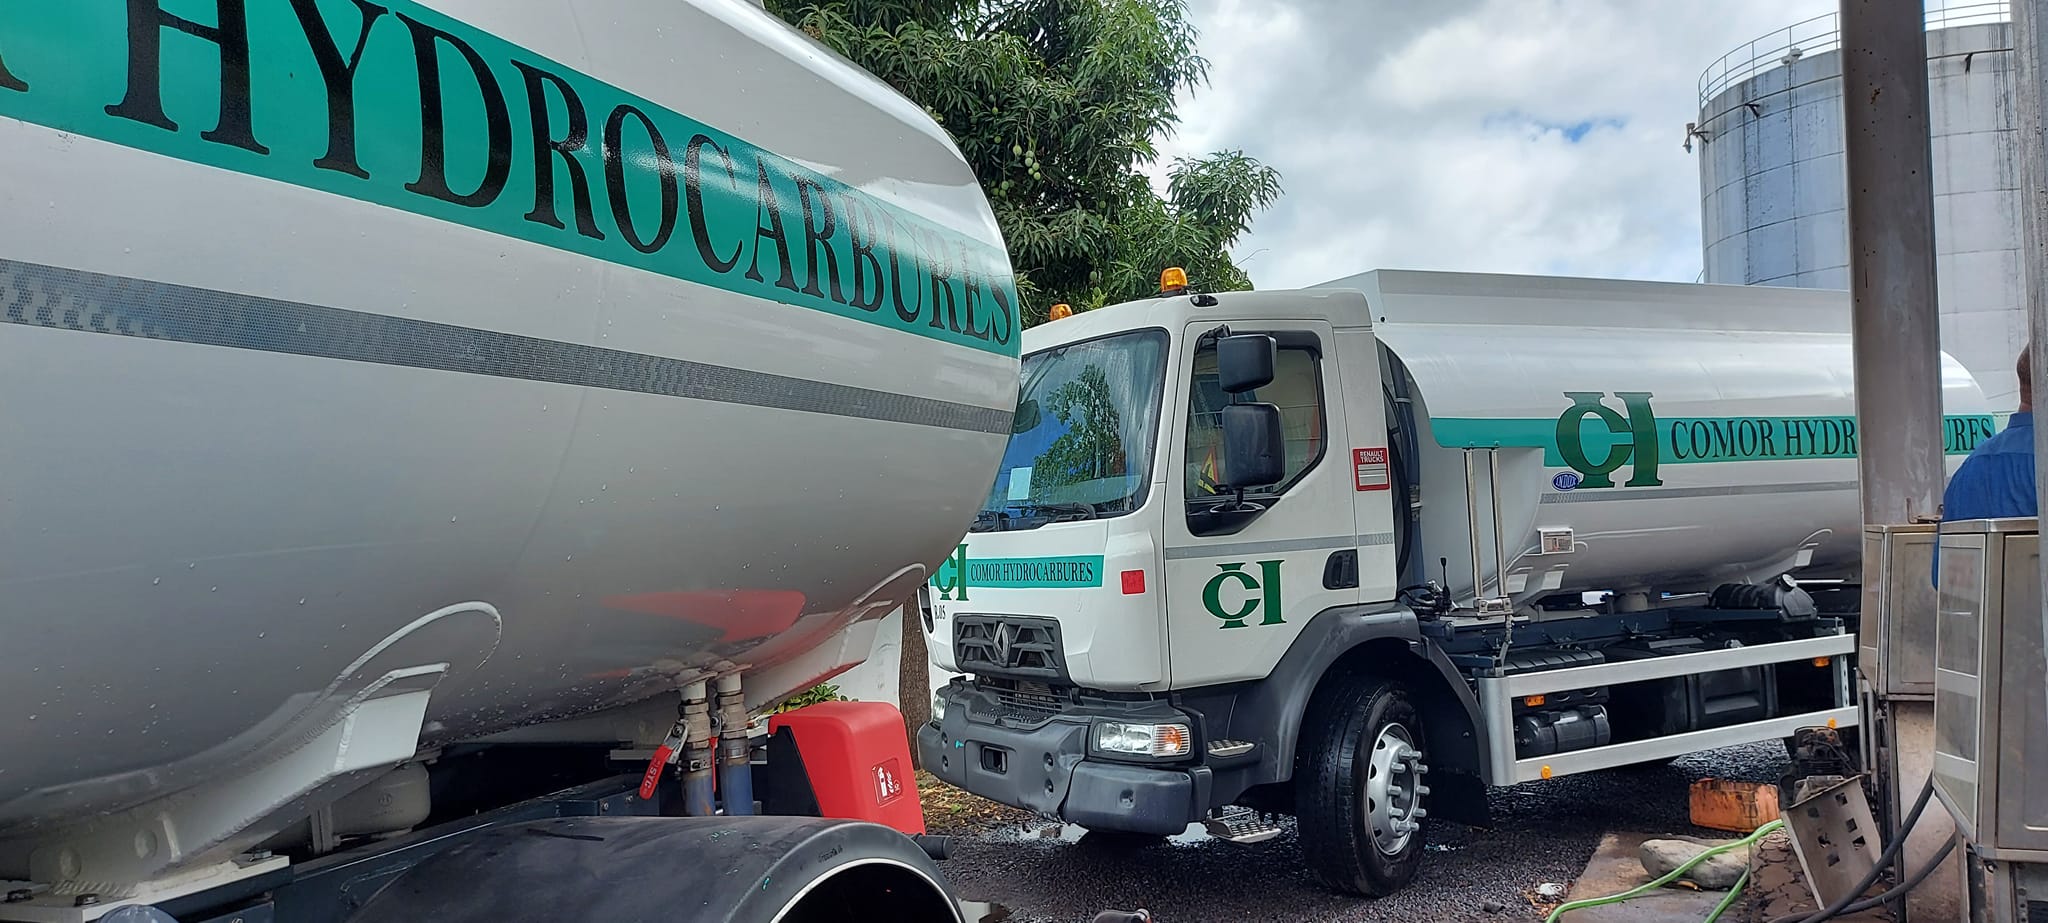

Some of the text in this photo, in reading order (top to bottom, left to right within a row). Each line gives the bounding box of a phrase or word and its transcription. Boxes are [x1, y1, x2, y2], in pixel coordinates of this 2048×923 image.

[104, 0, 1013, 346] HYDROCARBURES
[1671, 419, 1777, 460] COMOR
[970, 561, 1094, 582] COMOR HYDROCARBURES
